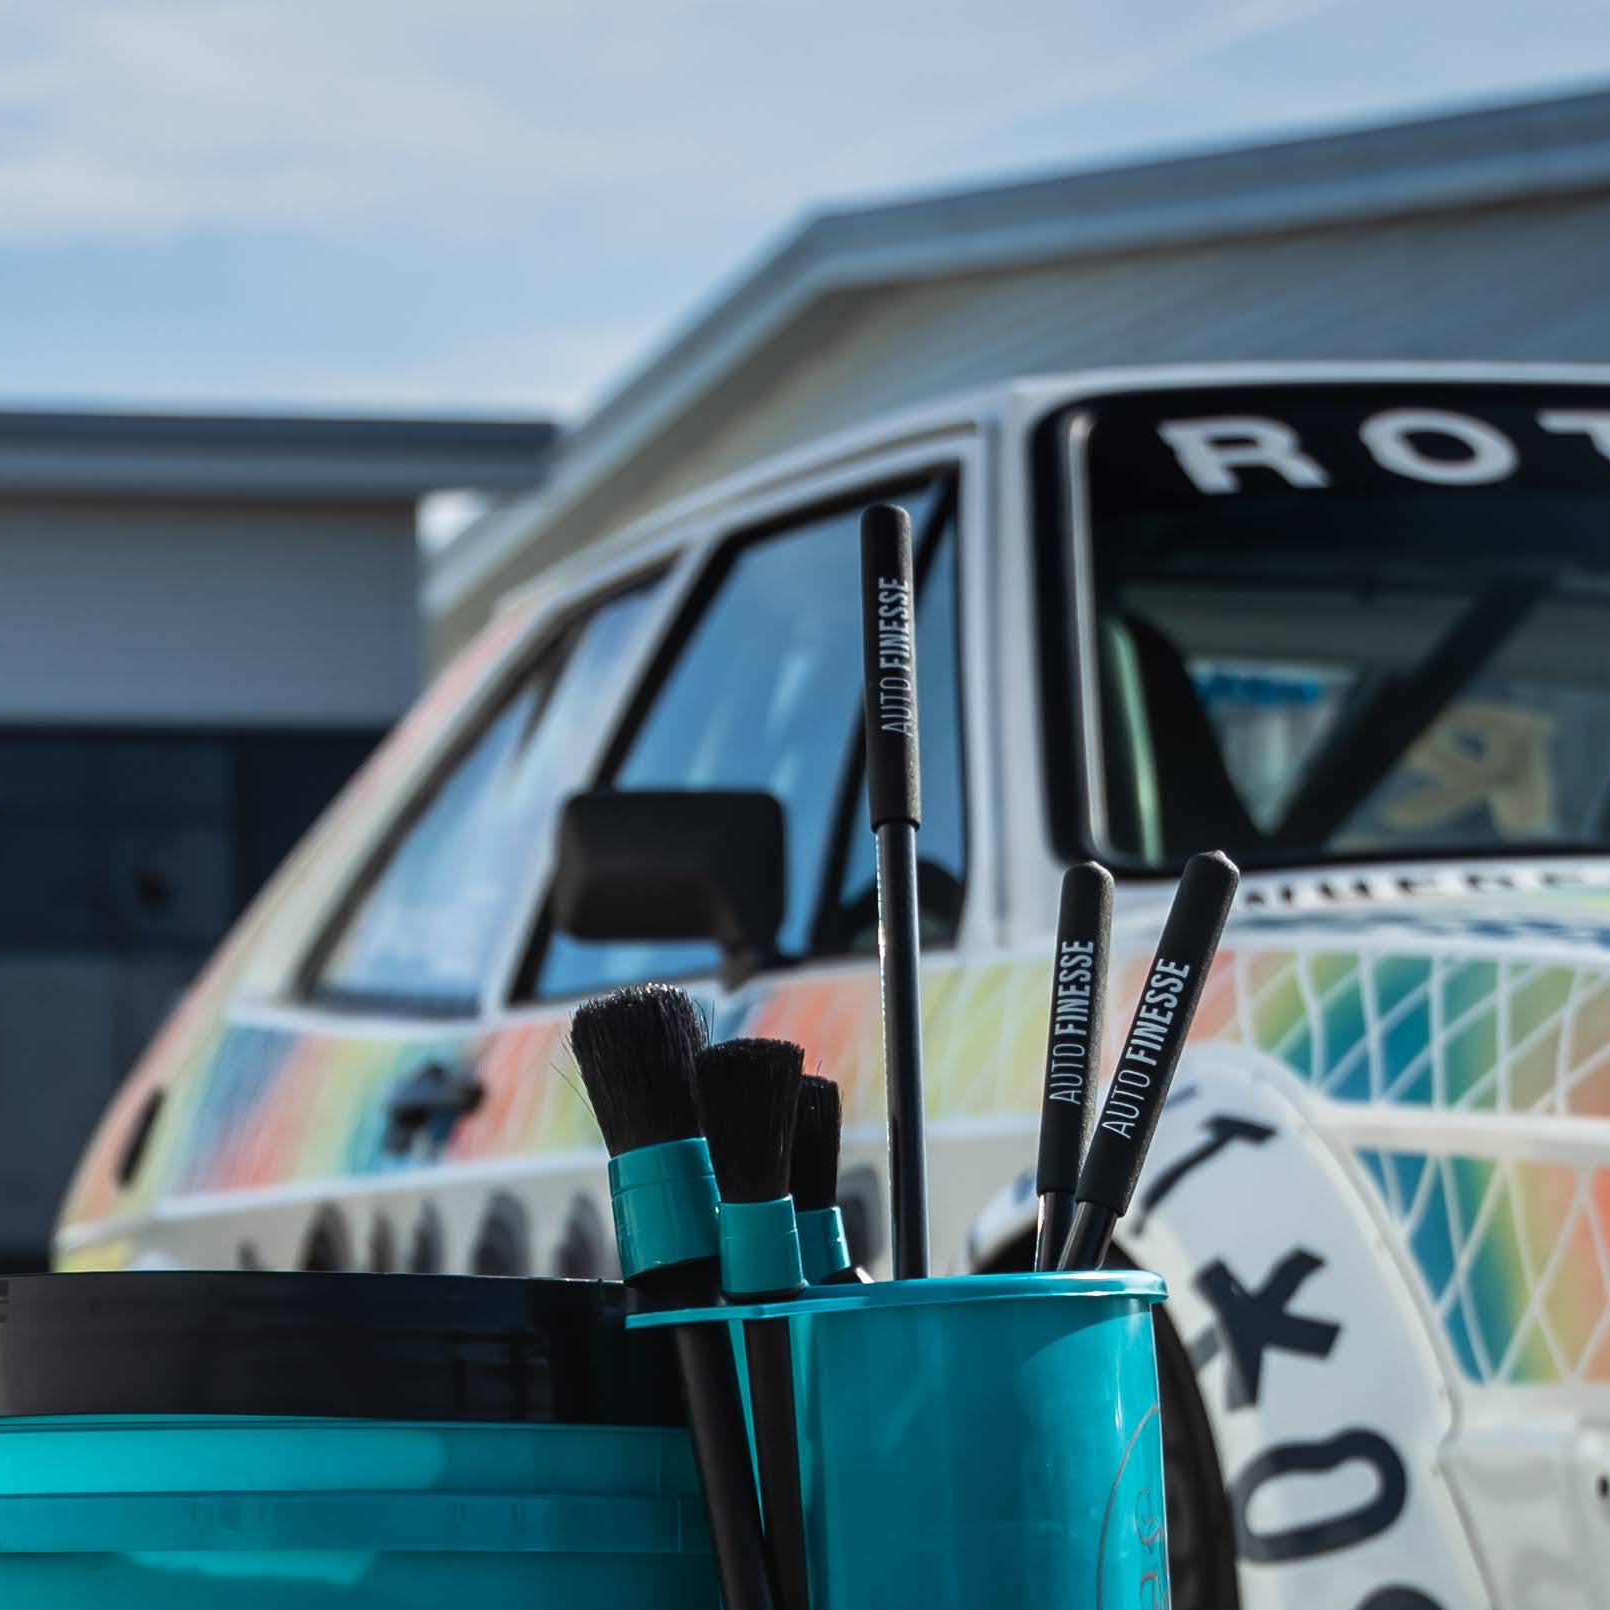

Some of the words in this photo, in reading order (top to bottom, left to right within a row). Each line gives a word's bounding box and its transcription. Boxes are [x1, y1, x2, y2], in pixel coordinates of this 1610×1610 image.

[878, 575, 910, 671] FINESSE
[880, 676, 913, 738] AUTO
[1054, 939, 1095, 1036] FINESSE
[1125, 957, 1190, 1067] FINESSE
[1049, 1042, 1086, 1105] AUTO
[1101, 1069, 1152, 1140] AUTO
